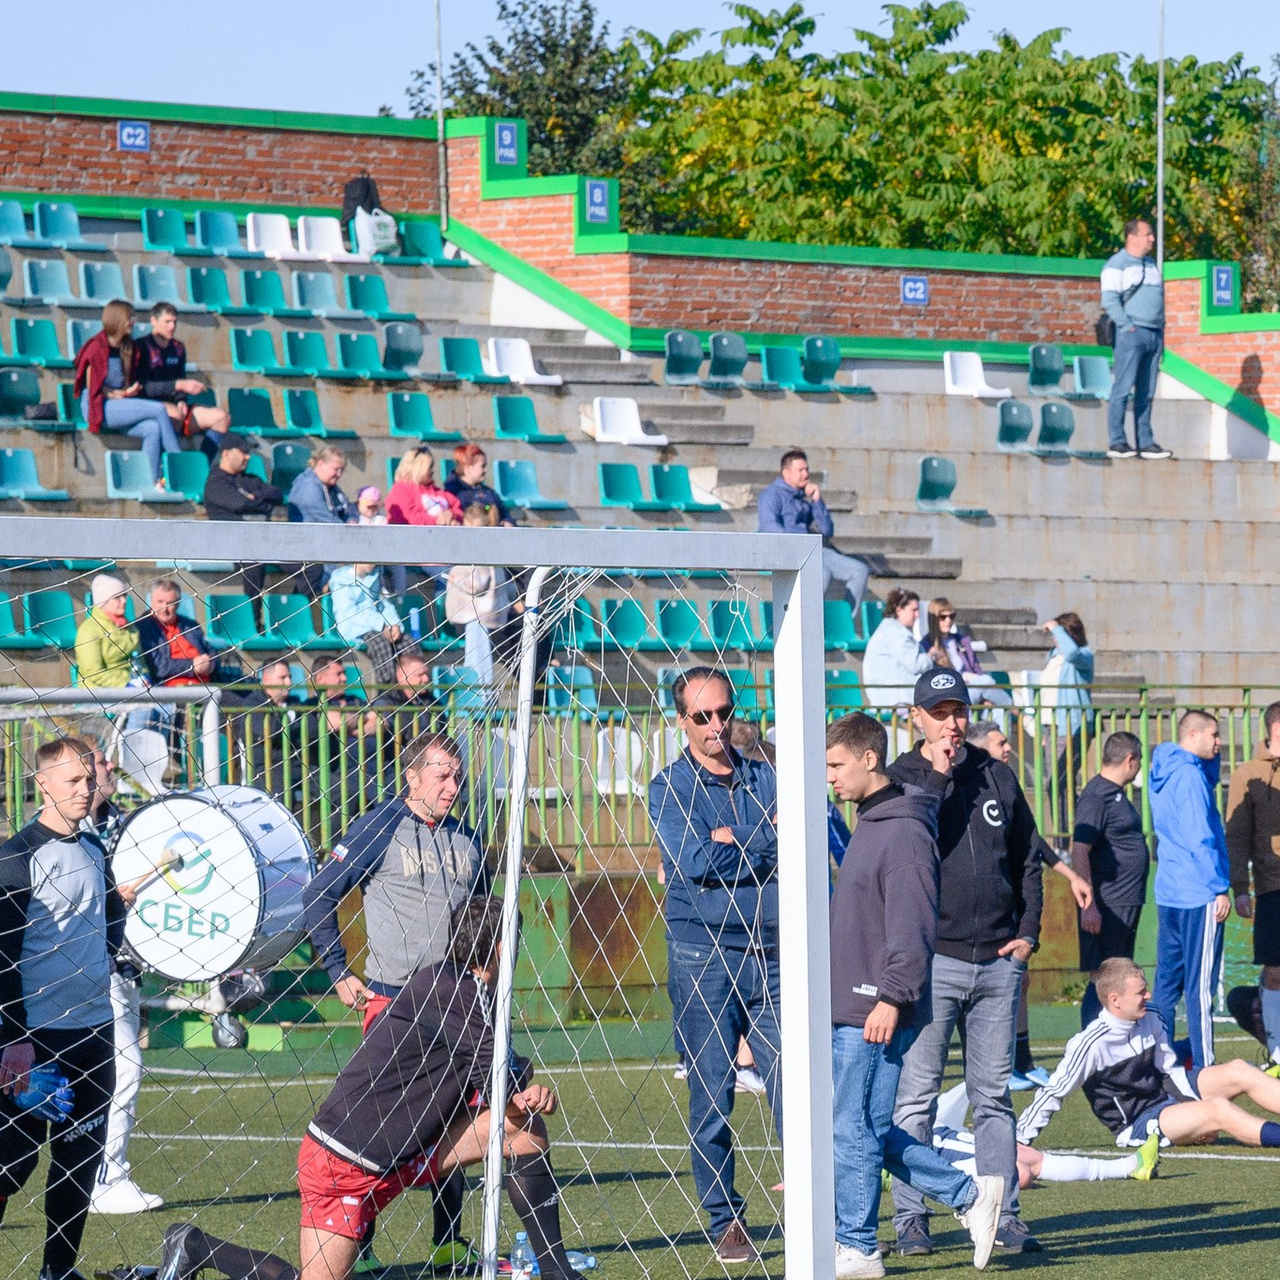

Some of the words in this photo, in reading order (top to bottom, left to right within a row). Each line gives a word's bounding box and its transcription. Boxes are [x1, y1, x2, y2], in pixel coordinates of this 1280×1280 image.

[501, 130, 512, 145] 9
[592, 188, 603, 203] 8
[1219, 273, 1228, 287] 7
[138, 899, 231, 941] СБЕР
